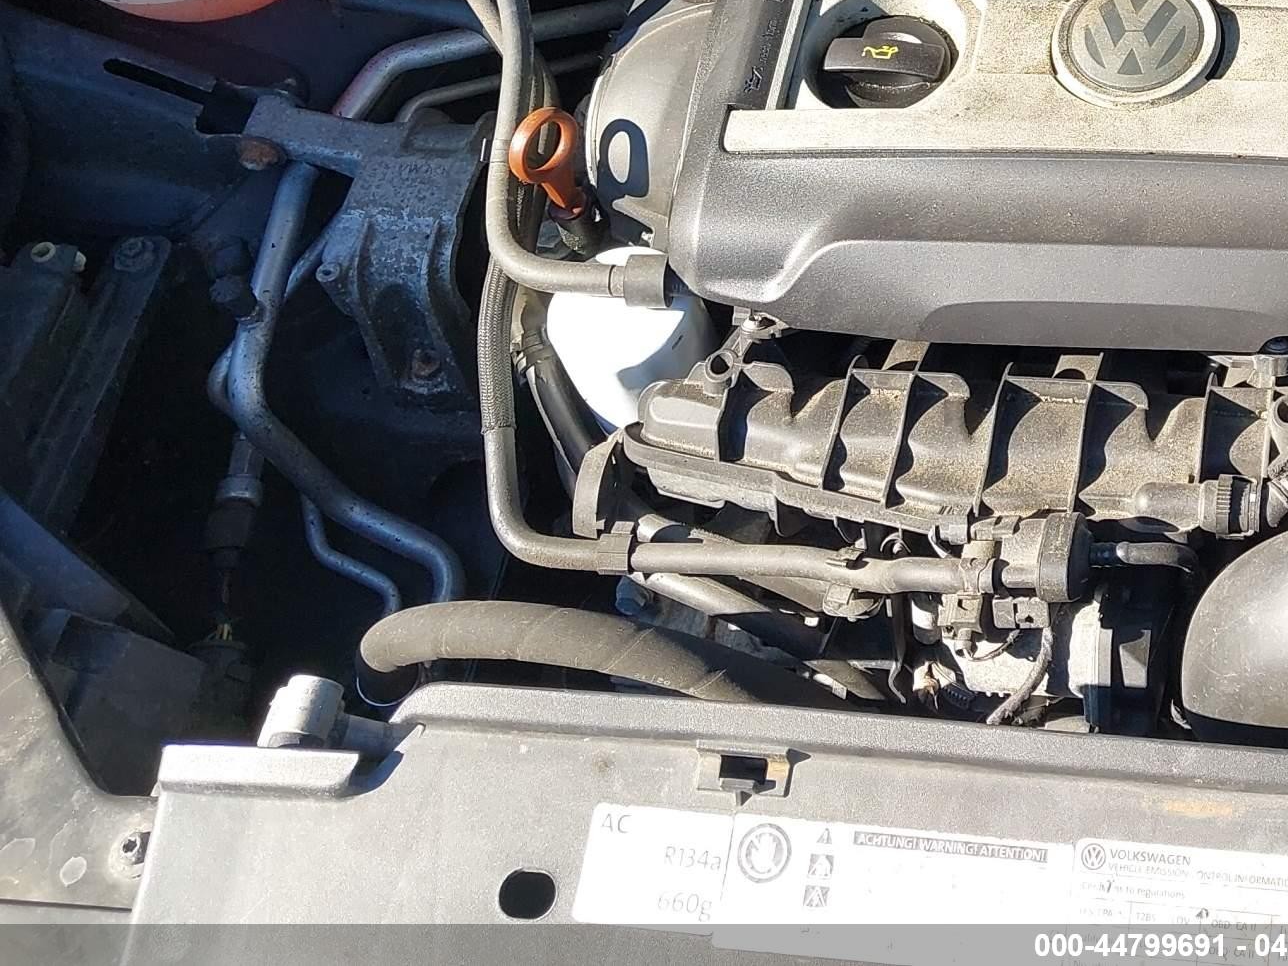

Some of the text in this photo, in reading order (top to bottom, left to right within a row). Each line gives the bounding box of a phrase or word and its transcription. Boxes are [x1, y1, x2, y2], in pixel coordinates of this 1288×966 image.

[600, 812, 633, 834] AC
[663, 845, 722, 871] R134a
[858, 833, 1046, 862] ACHTUNG! WARNING! ATTENTION!
[1109, 848, 1192, 867] VOLKSWAGEN
[657, 891, 713, 923] 660g
